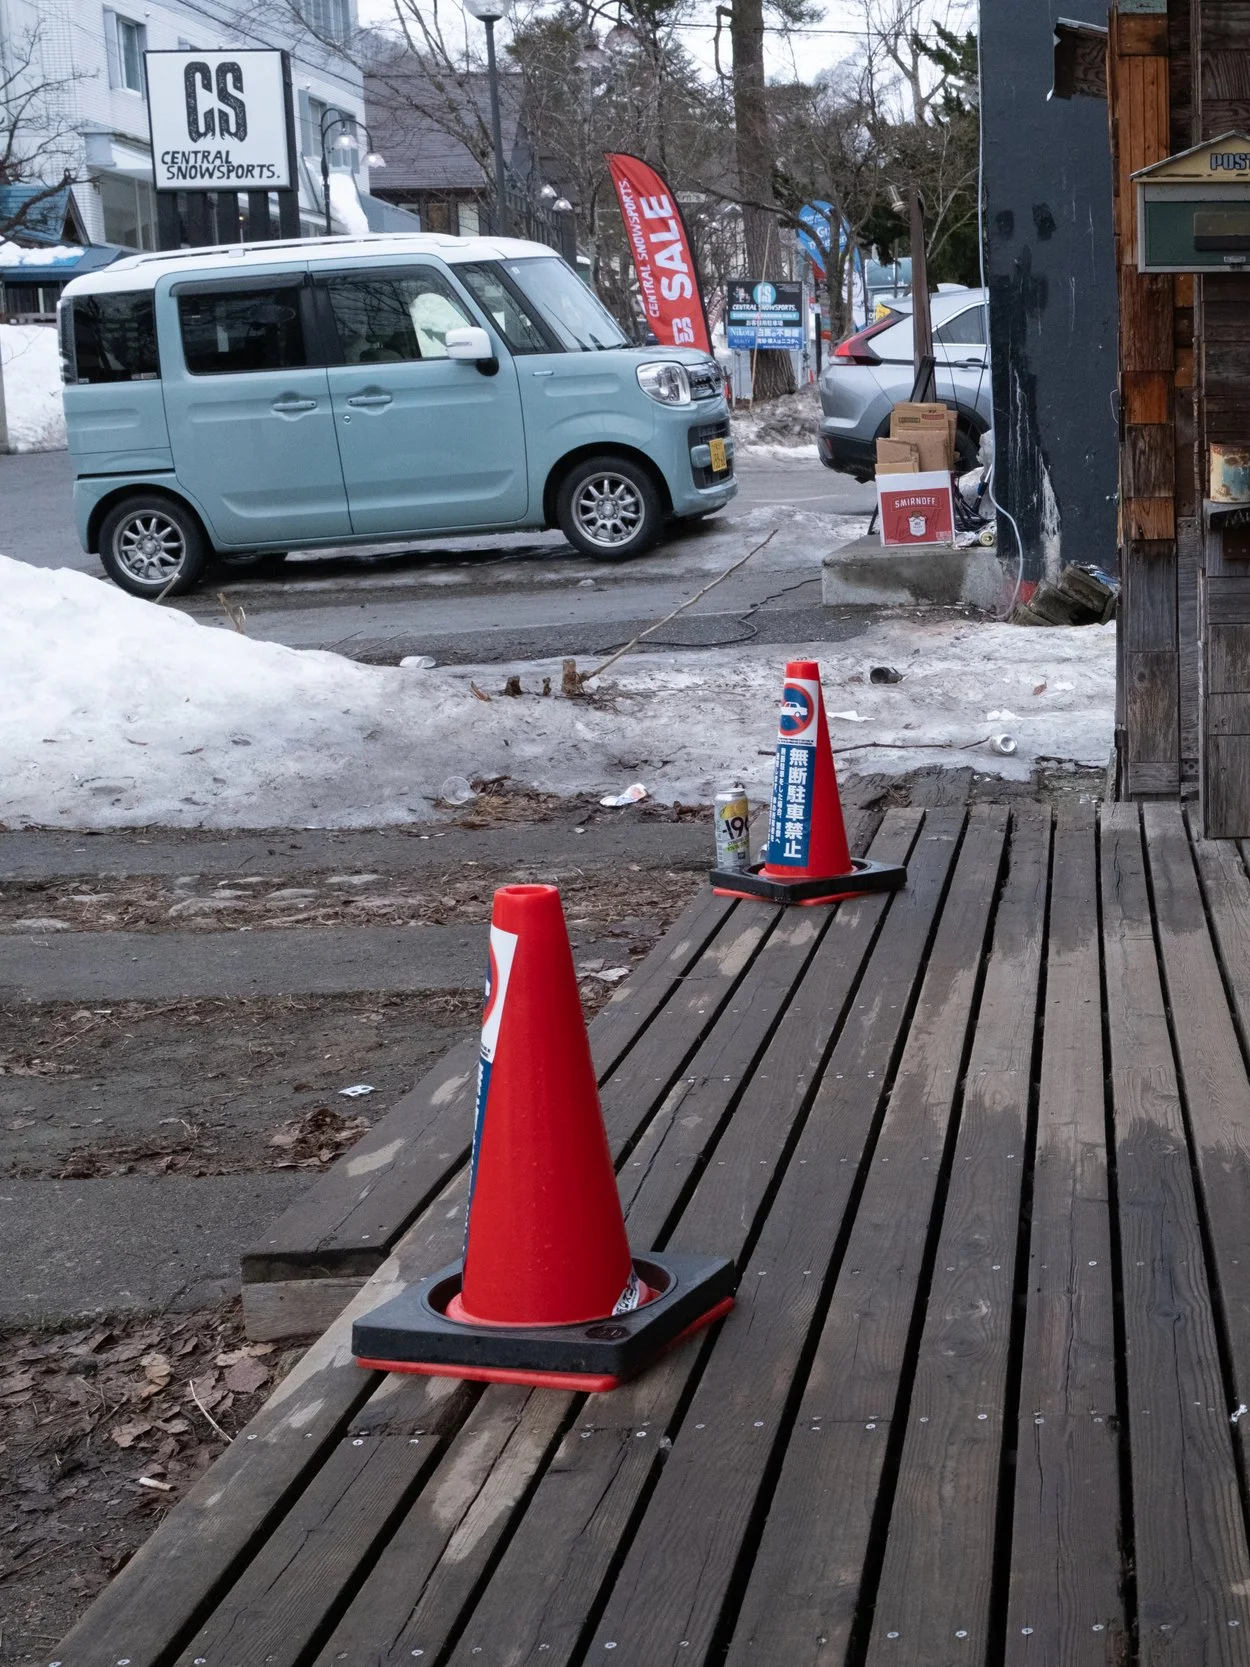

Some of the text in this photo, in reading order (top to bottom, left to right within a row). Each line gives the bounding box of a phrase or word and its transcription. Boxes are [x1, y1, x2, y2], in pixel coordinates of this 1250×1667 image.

[184, 61, 248, 143] CS
[161, 150, 232, 165] CENTRAL
[166, 164, 280, 180] SNOWSPORTS.
[640, 194, 693, 301] SALE
[641, 264, 660, 318] CENTRAL
[672, 317, 695, 345] CS
[894, 497, 936, 508] SMIRNOFF
[783, 748, 809, 859] 無断駐車禁止
